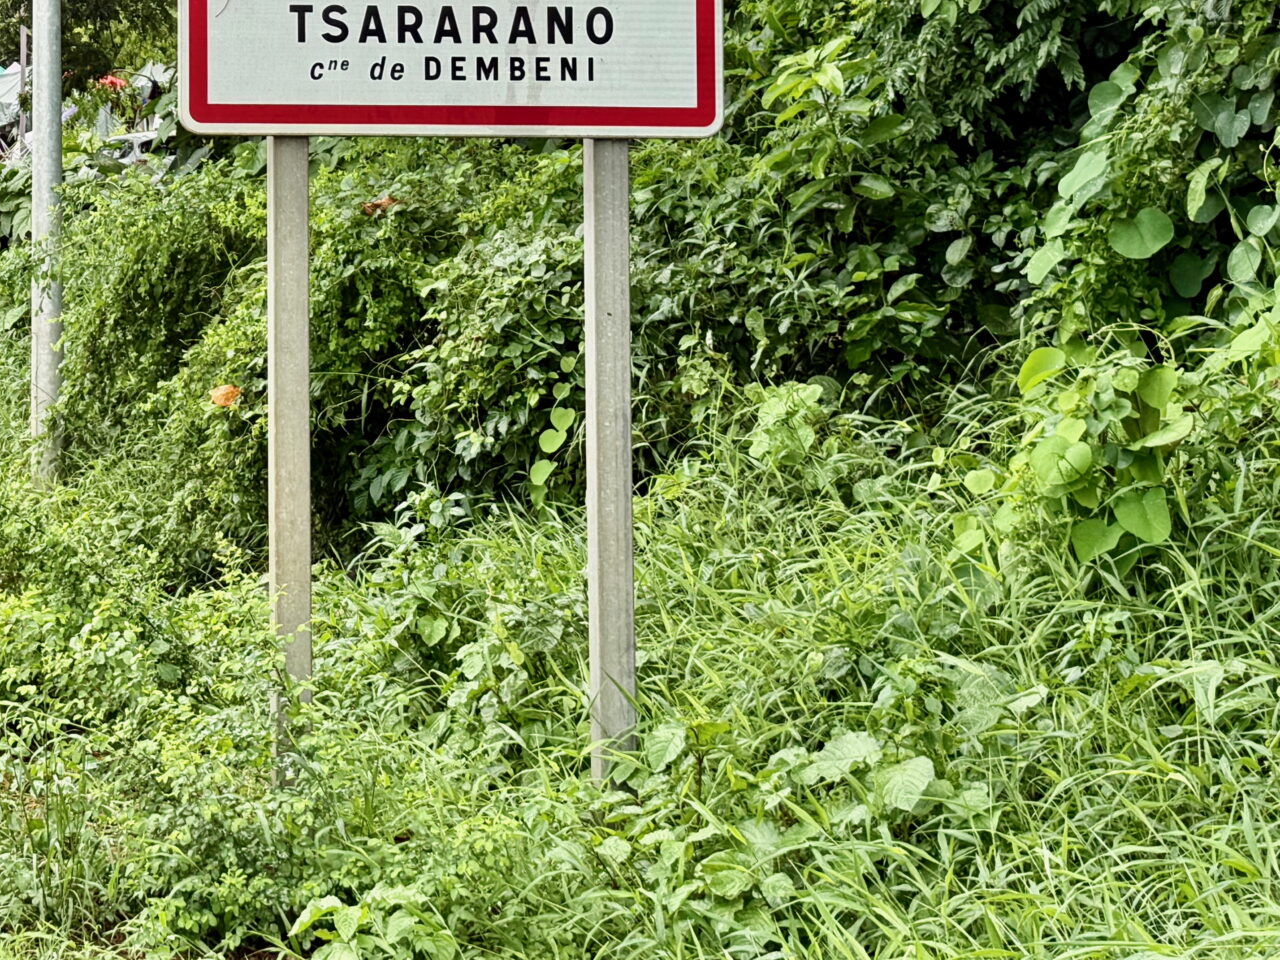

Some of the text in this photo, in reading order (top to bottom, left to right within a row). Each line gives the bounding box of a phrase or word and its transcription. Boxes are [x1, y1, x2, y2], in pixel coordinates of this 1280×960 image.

[290, 4, 614, 45] TSARARANO
[369, 55, 405, 81] de
[424, 56, 594, 81] DEMBENI
